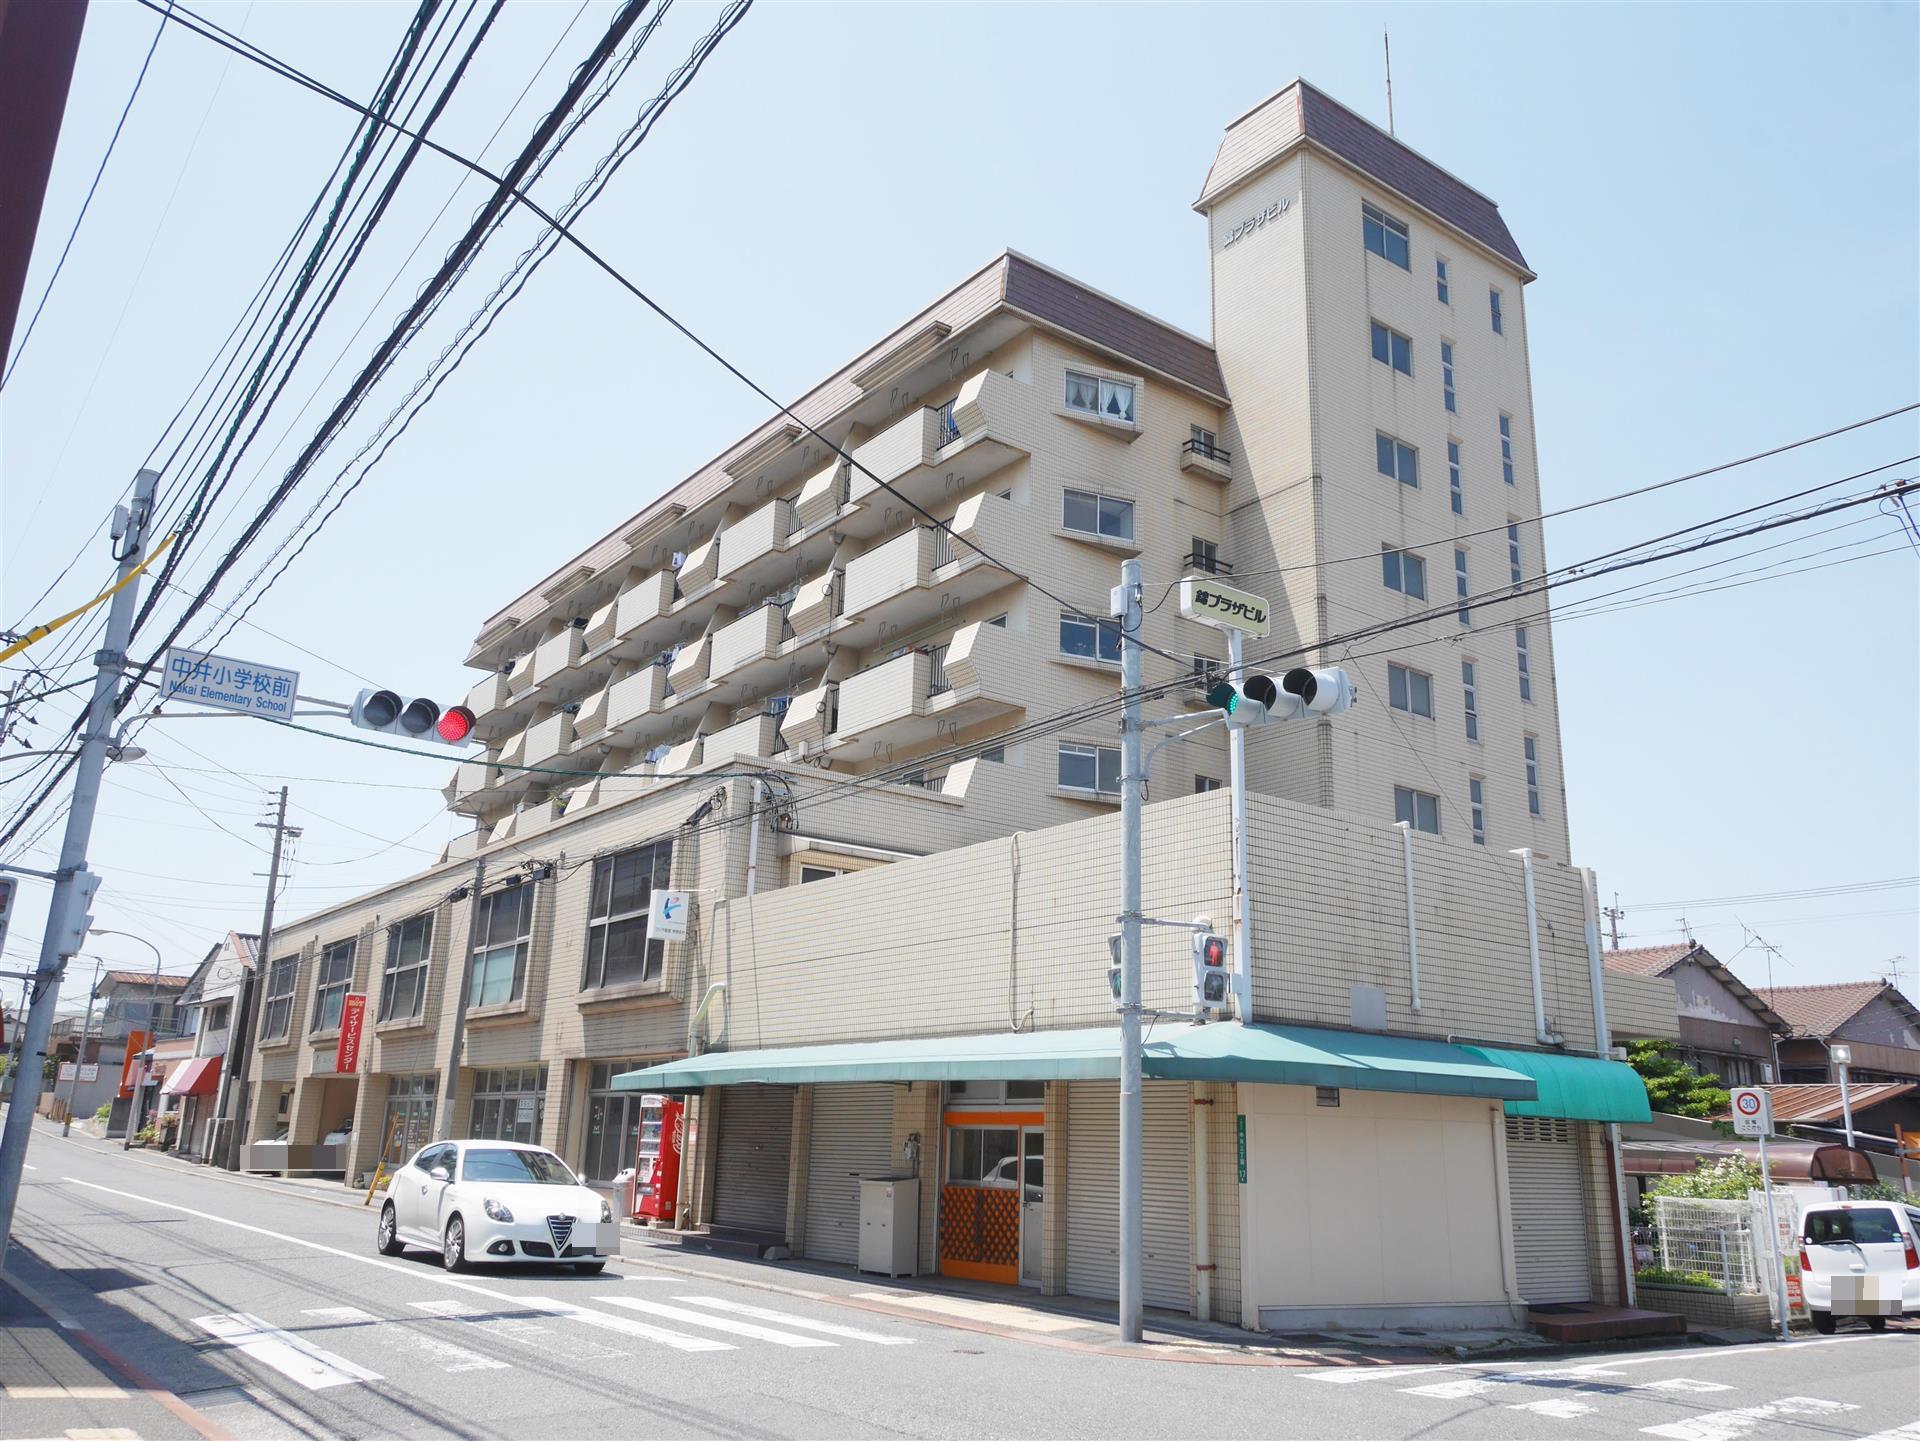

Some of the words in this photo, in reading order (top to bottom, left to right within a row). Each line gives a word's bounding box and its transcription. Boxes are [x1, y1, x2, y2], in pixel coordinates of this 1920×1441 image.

[168, 680, 197, 696] Nakai
[200, 686, 252, 708] Elementary
[256, 696, 287, 713] School
[172, 656, 292, 699] 中井小学校前
[343, 1008, 360, 1070] デイサービスセンター
[1742, 1098, 1756, 1110] 30
